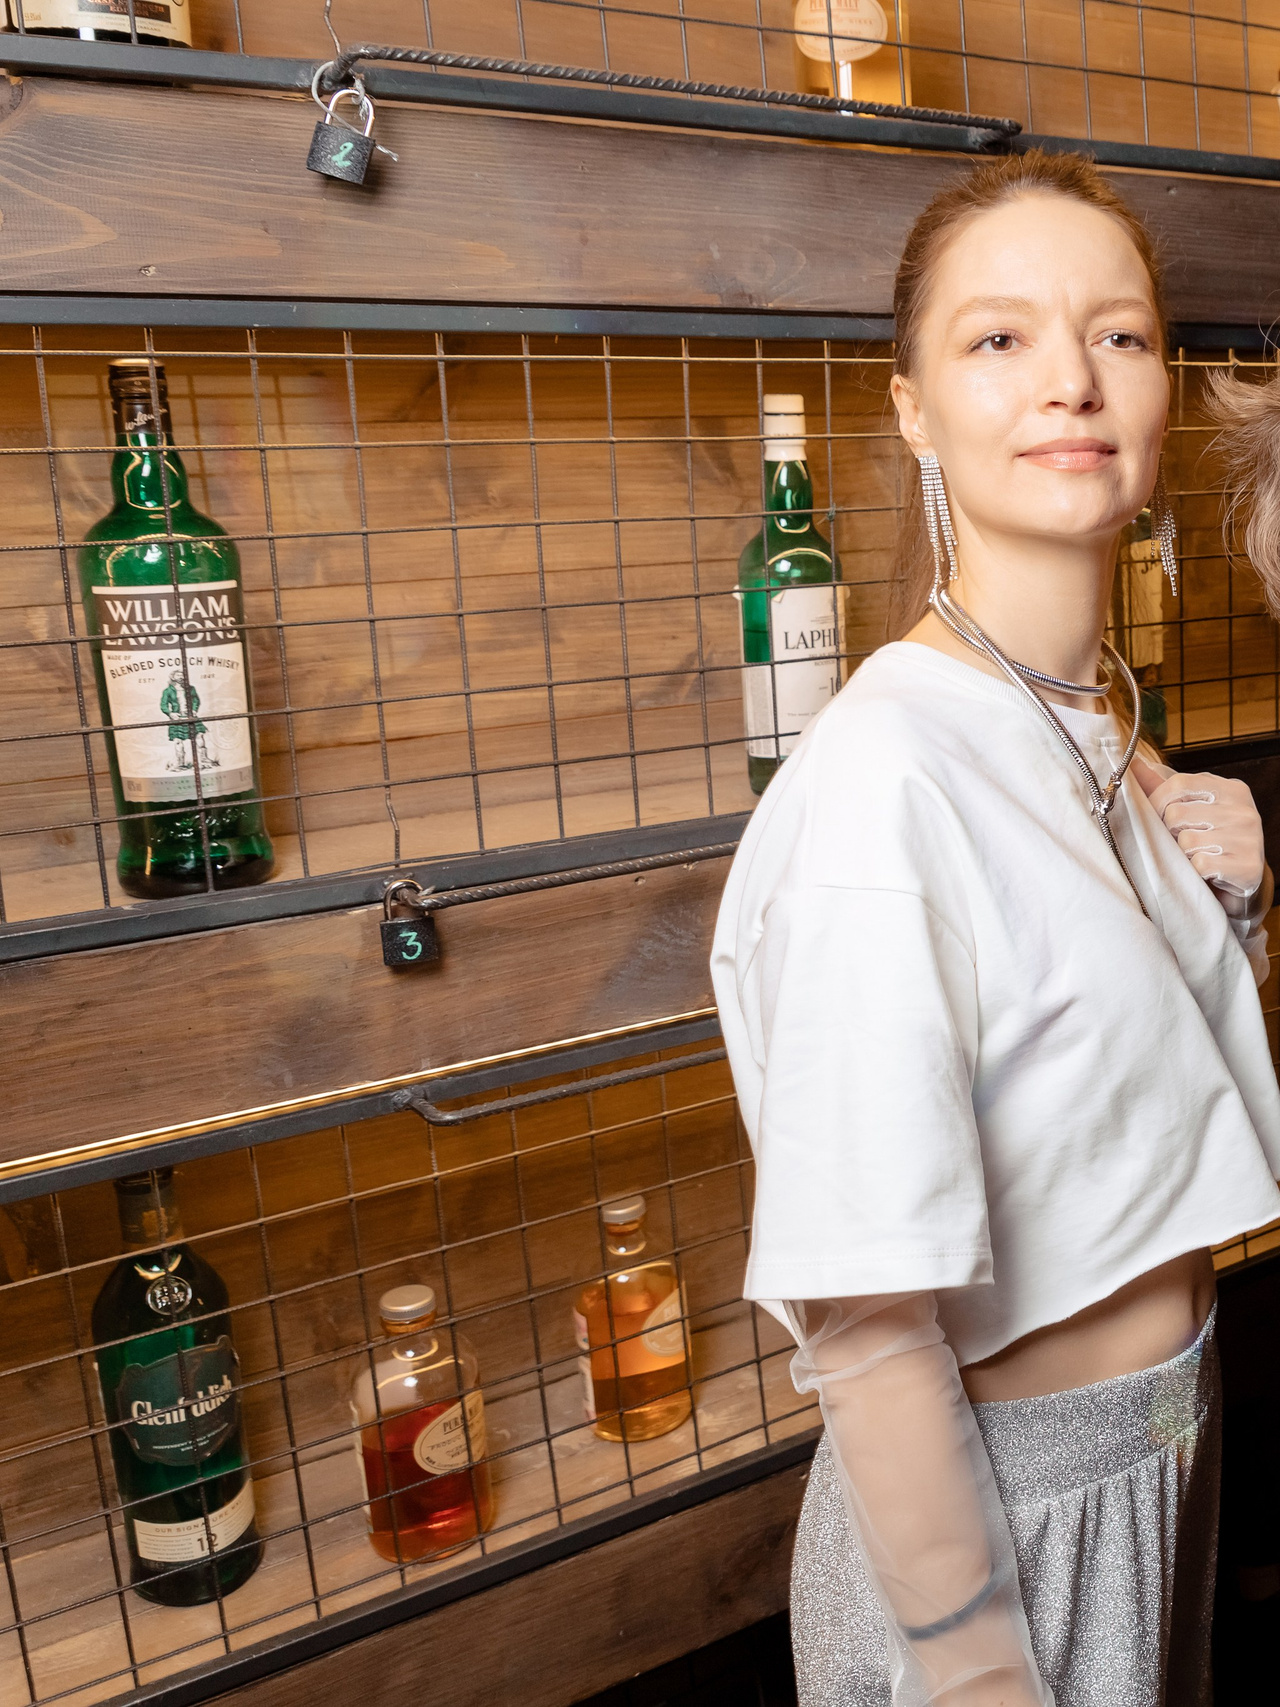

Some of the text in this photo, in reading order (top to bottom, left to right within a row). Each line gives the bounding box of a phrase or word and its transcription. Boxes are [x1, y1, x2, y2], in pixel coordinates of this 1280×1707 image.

[331, 141, 354, 169] 2
[104, 594, 231, 622] WILLIAM
[102, 616, 238, 646] LAWSON'S
[109, 656, 241, 680] BLENDED SCOCH WHISKY
[399, 931, 423, 960] 3
[131, 1374, 234, 1427] Glenfddich
[176, 1510, 229, 1533] SIGNAURE
[197, 1532, 219, 1552] 12
